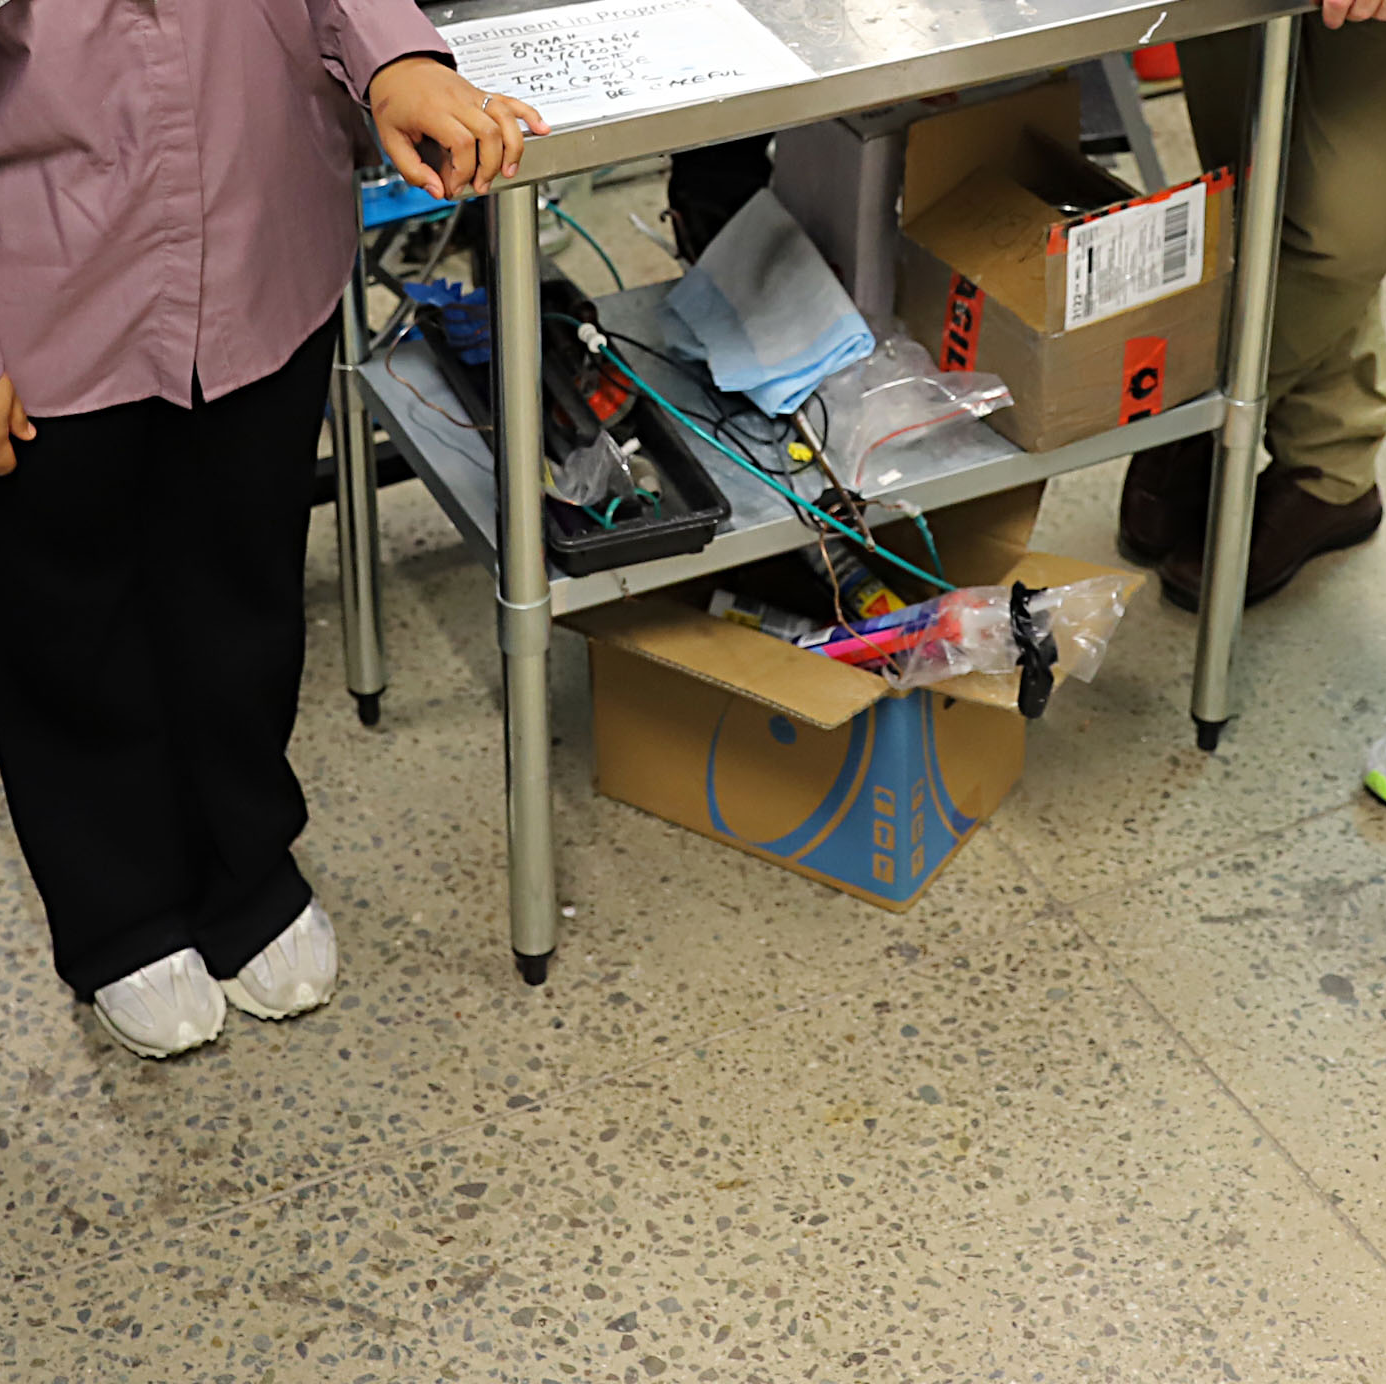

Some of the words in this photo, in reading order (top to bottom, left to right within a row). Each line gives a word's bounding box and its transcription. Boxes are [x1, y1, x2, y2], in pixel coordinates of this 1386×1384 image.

[447, 19, 561, 46] periment
[605, 88, 634, 100] BE
[648, 70, 746, 91] CAREFUL
